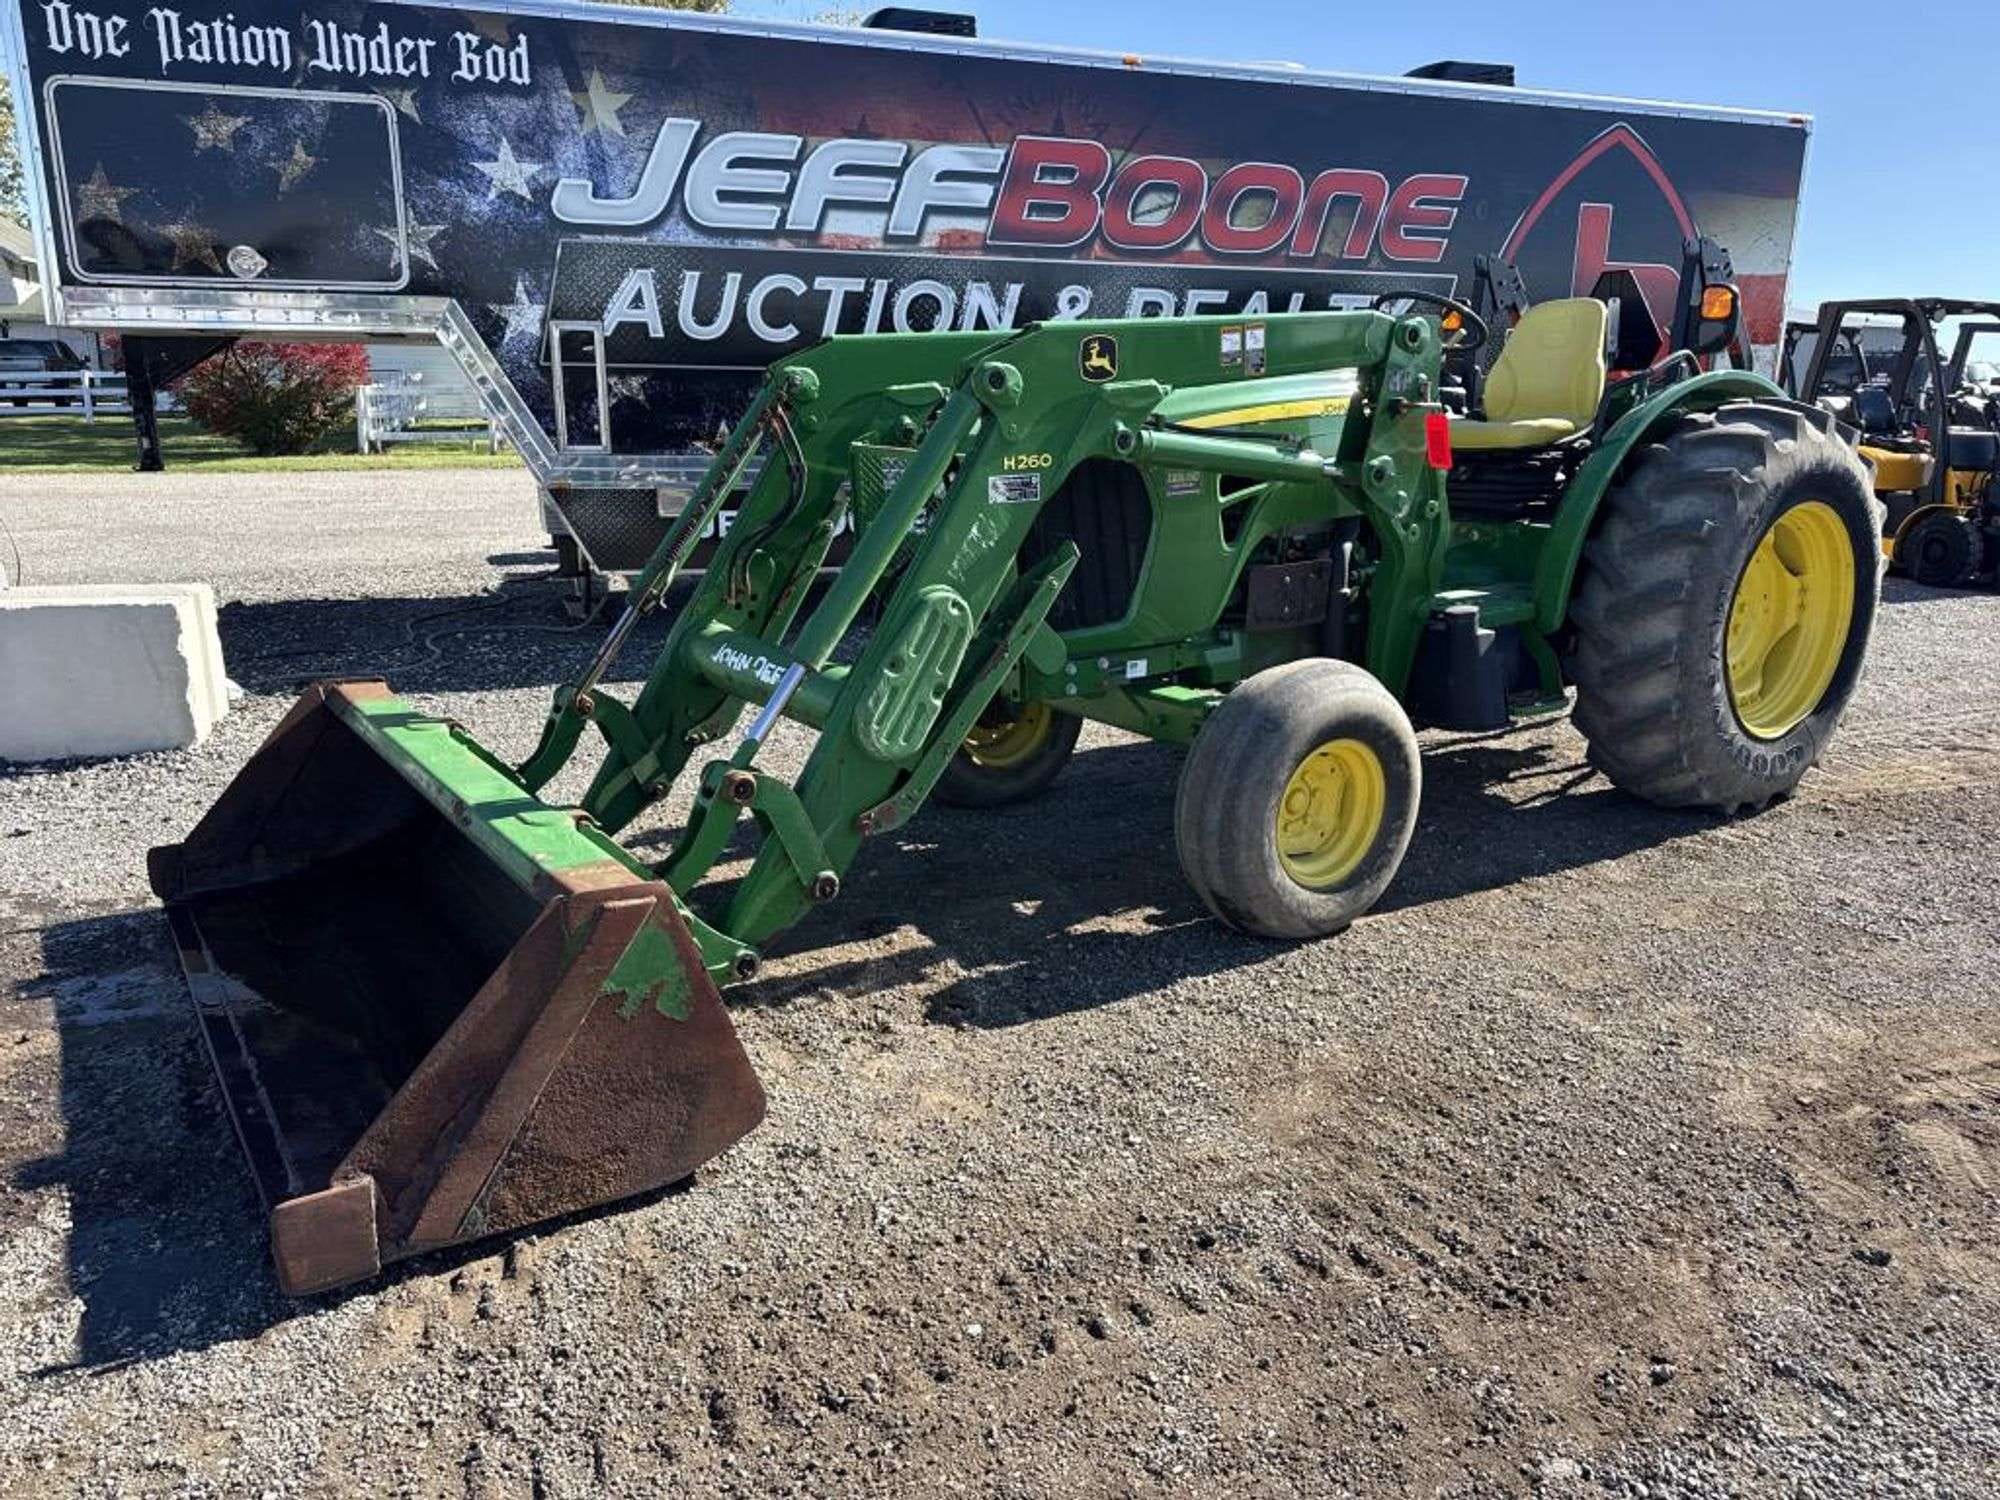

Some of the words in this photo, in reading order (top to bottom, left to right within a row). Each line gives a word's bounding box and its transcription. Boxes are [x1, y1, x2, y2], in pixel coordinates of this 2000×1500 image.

[40, 0, 130, 60] One
[143, 7, 291, 76] Nation
[306, 19, 437, 78] Under
[449, 31, 531, 85] God
[602, 268, 1026, 343] AUCTION
[1003, 453, 1053, 471] H260
[711, 642, 753, 672] JOHN
